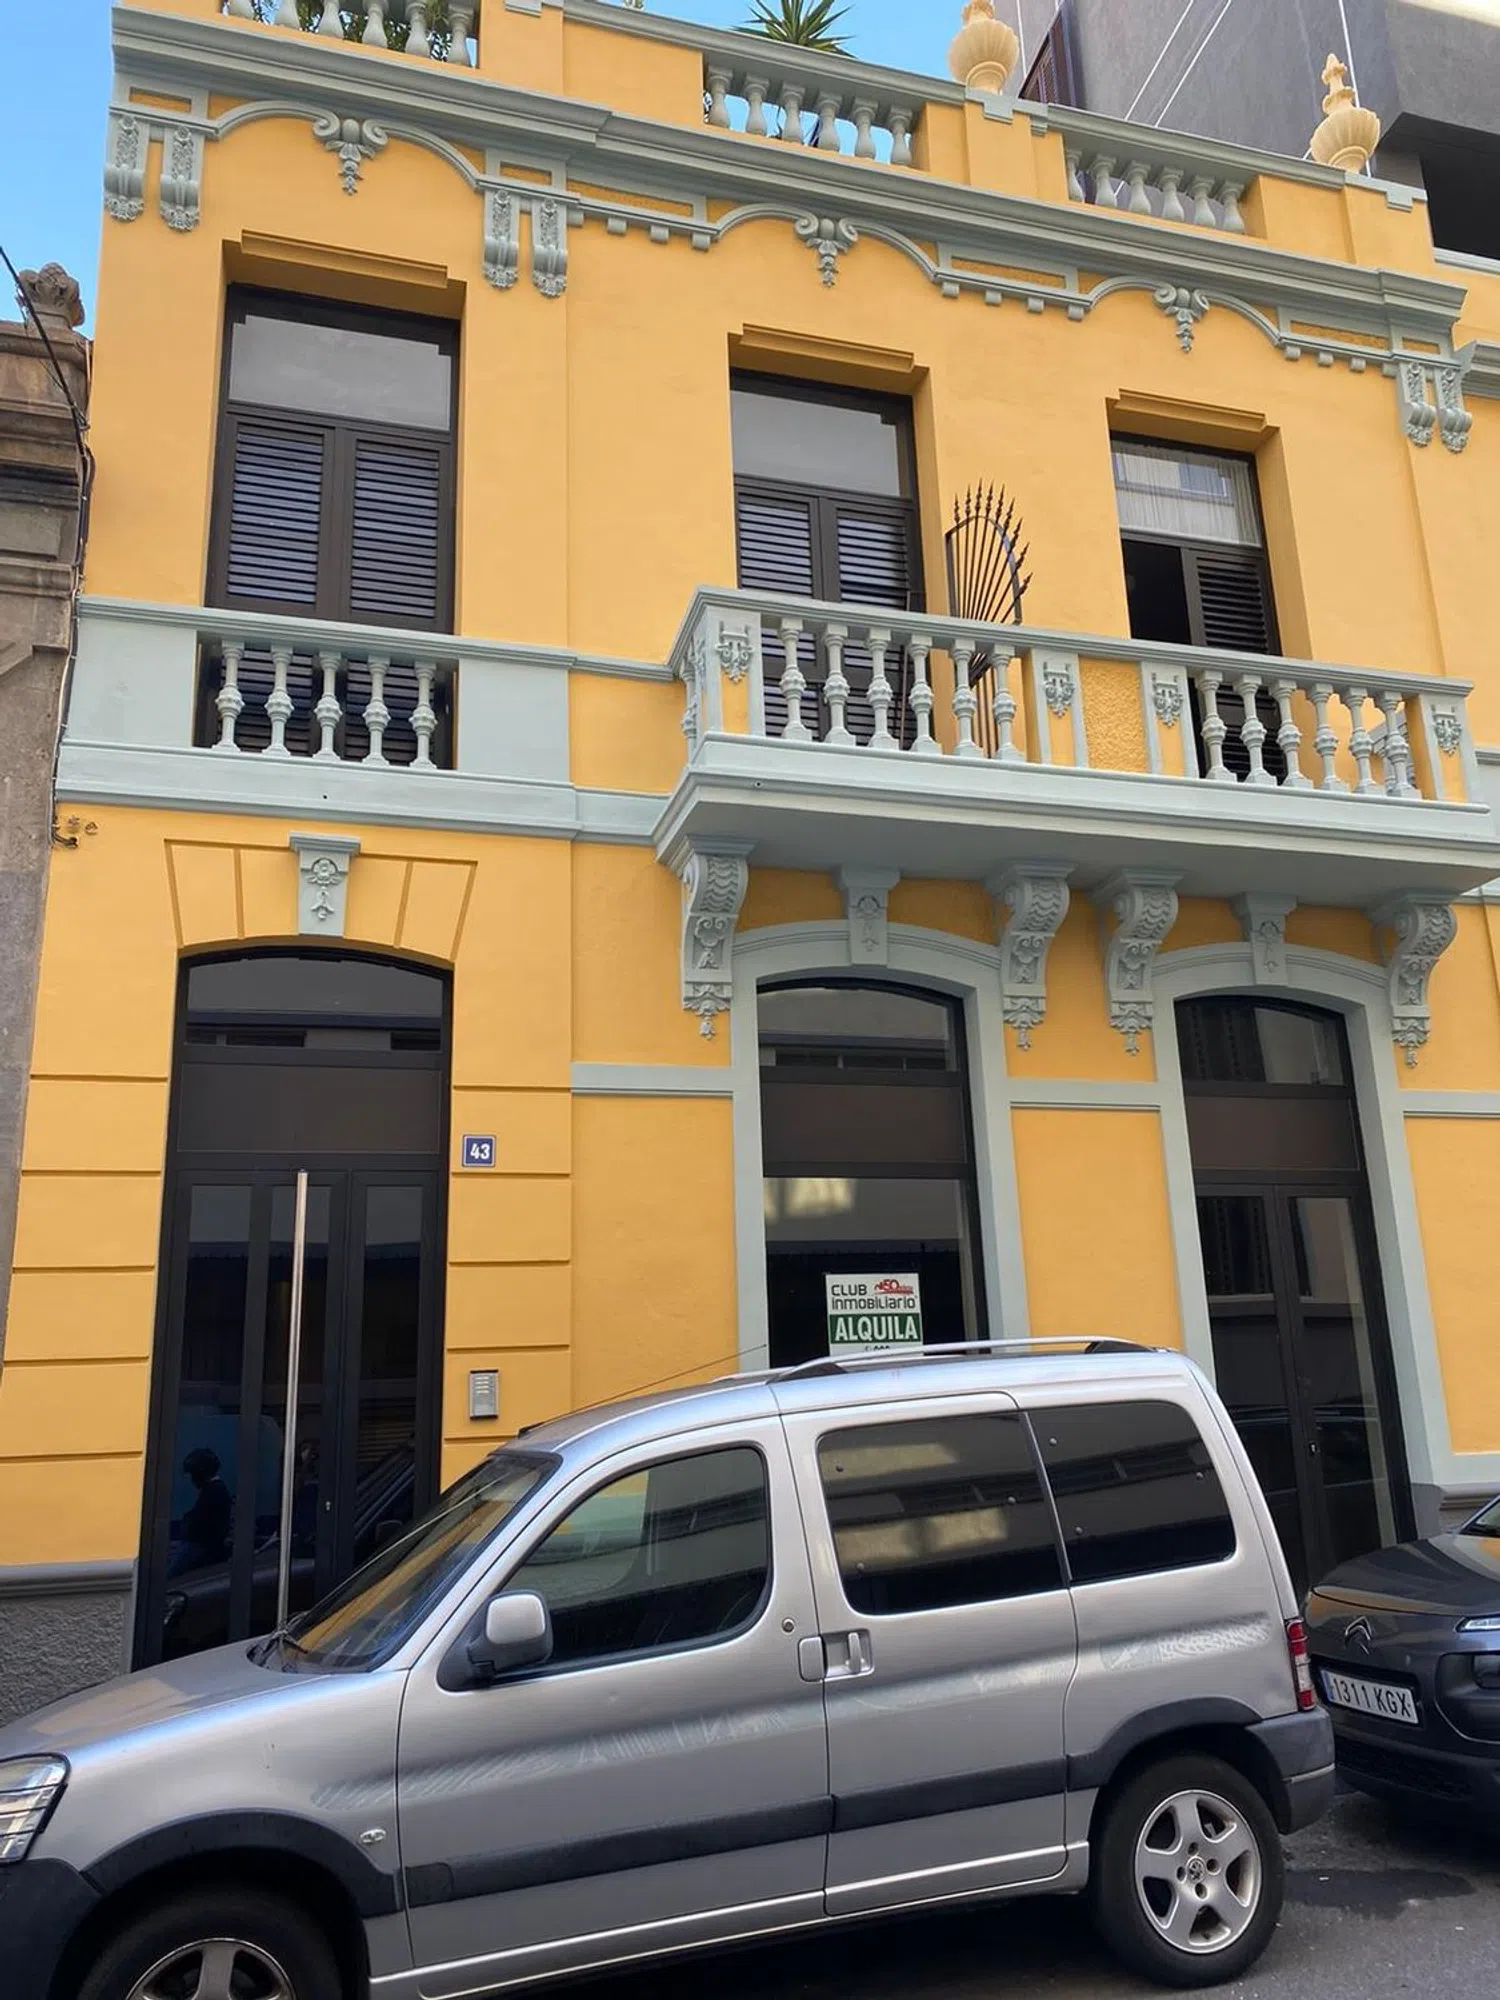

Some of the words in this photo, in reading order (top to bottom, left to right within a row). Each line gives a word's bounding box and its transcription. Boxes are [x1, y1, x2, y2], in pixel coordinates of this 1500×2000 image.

[470, 1143, 490, 1160] 43
[831, 1284, 867, 1296] CLUB
[835, 1316, 918, 1341] ALQUILA
[1333, 1678, 1371, 1708] 1311
[1373, 1687, 1411, 1718] KGX
